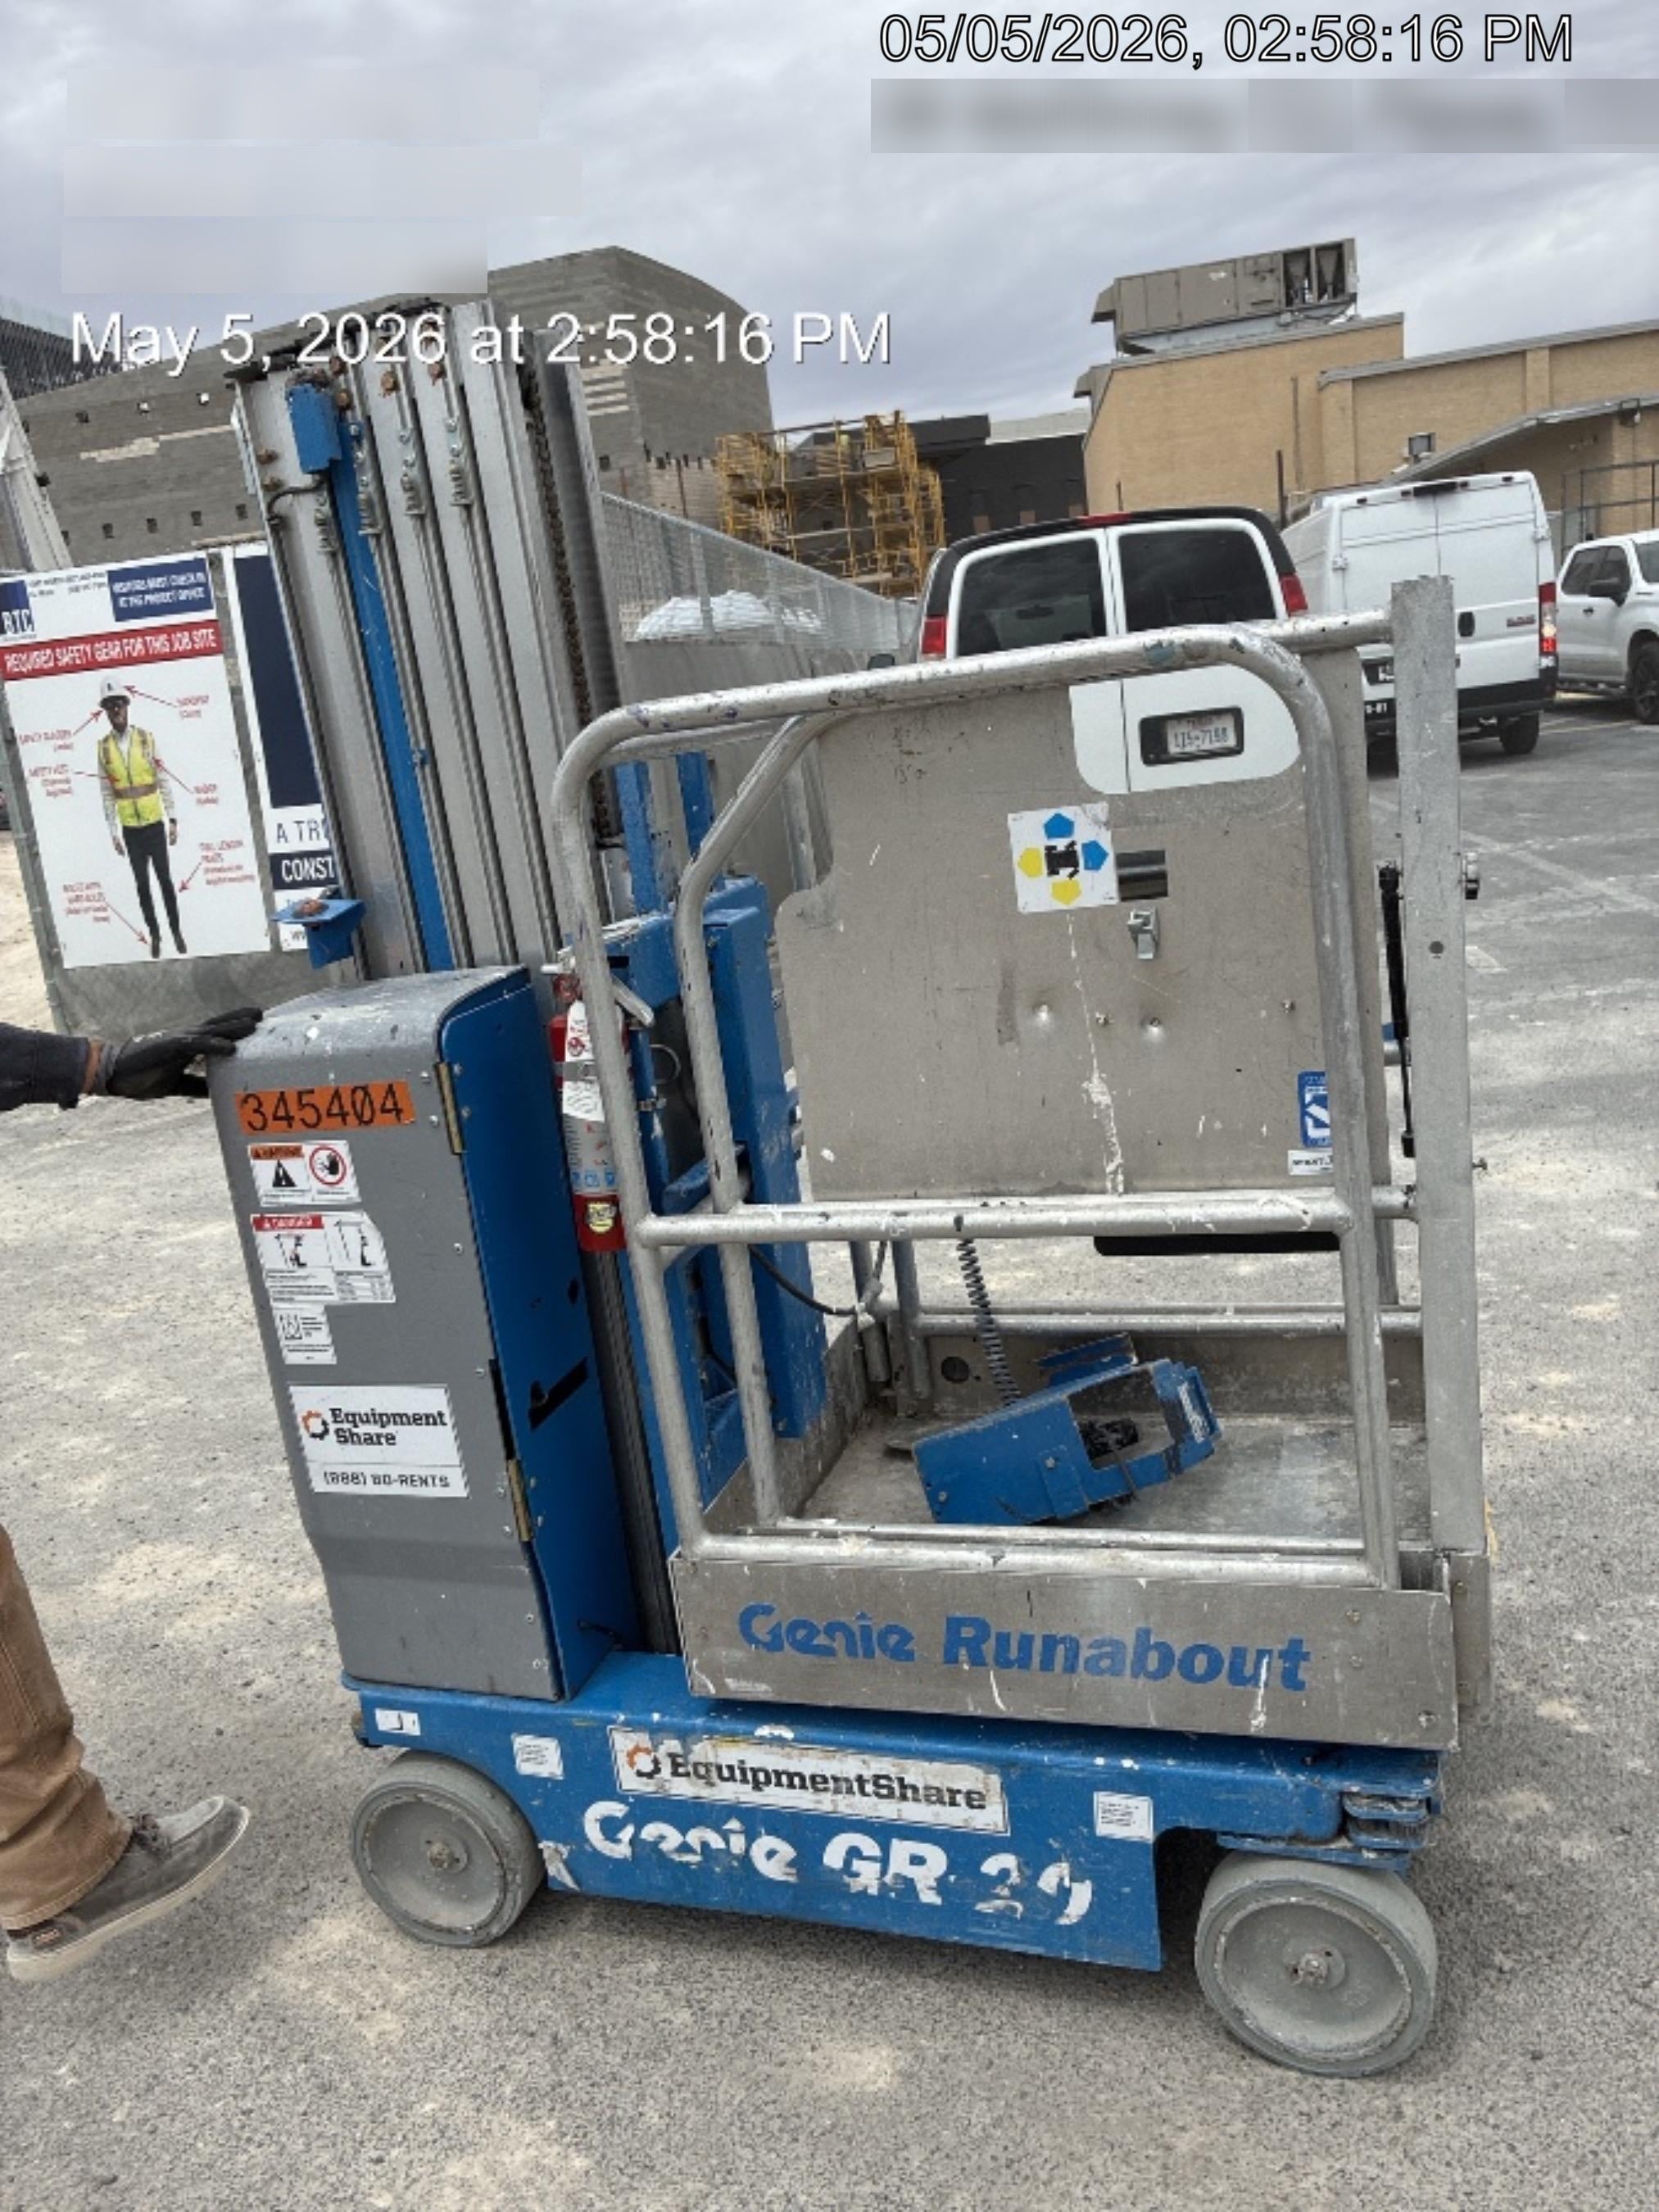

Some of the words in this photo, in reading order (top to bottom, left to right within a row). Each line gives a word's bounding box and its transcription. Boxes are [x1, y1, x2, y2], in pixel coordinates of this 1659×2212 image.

[56, 646, 92, 667] SAFETY
[94, 641, 123, 660] GEAR
[146, 635, 170, 655] THIS
[171, 631, 193, 651] JOB
[194, 628, 217, 649] SITE
[276, 822, 288, 844] A
[281, 855, 335, 884] CONST
[243, 1083, 405, 1132] 345404
[329, 1407, 447, 1428] Equipment
[334, 1427, 397, 1446] Share
[739, 1602, 915, 1663] Genie
[943, 1616, 1311, 1692] Runabout
[668, 1750, 986, 1811] EquipmentShare
[823, 1831, 950, 1906] GR
